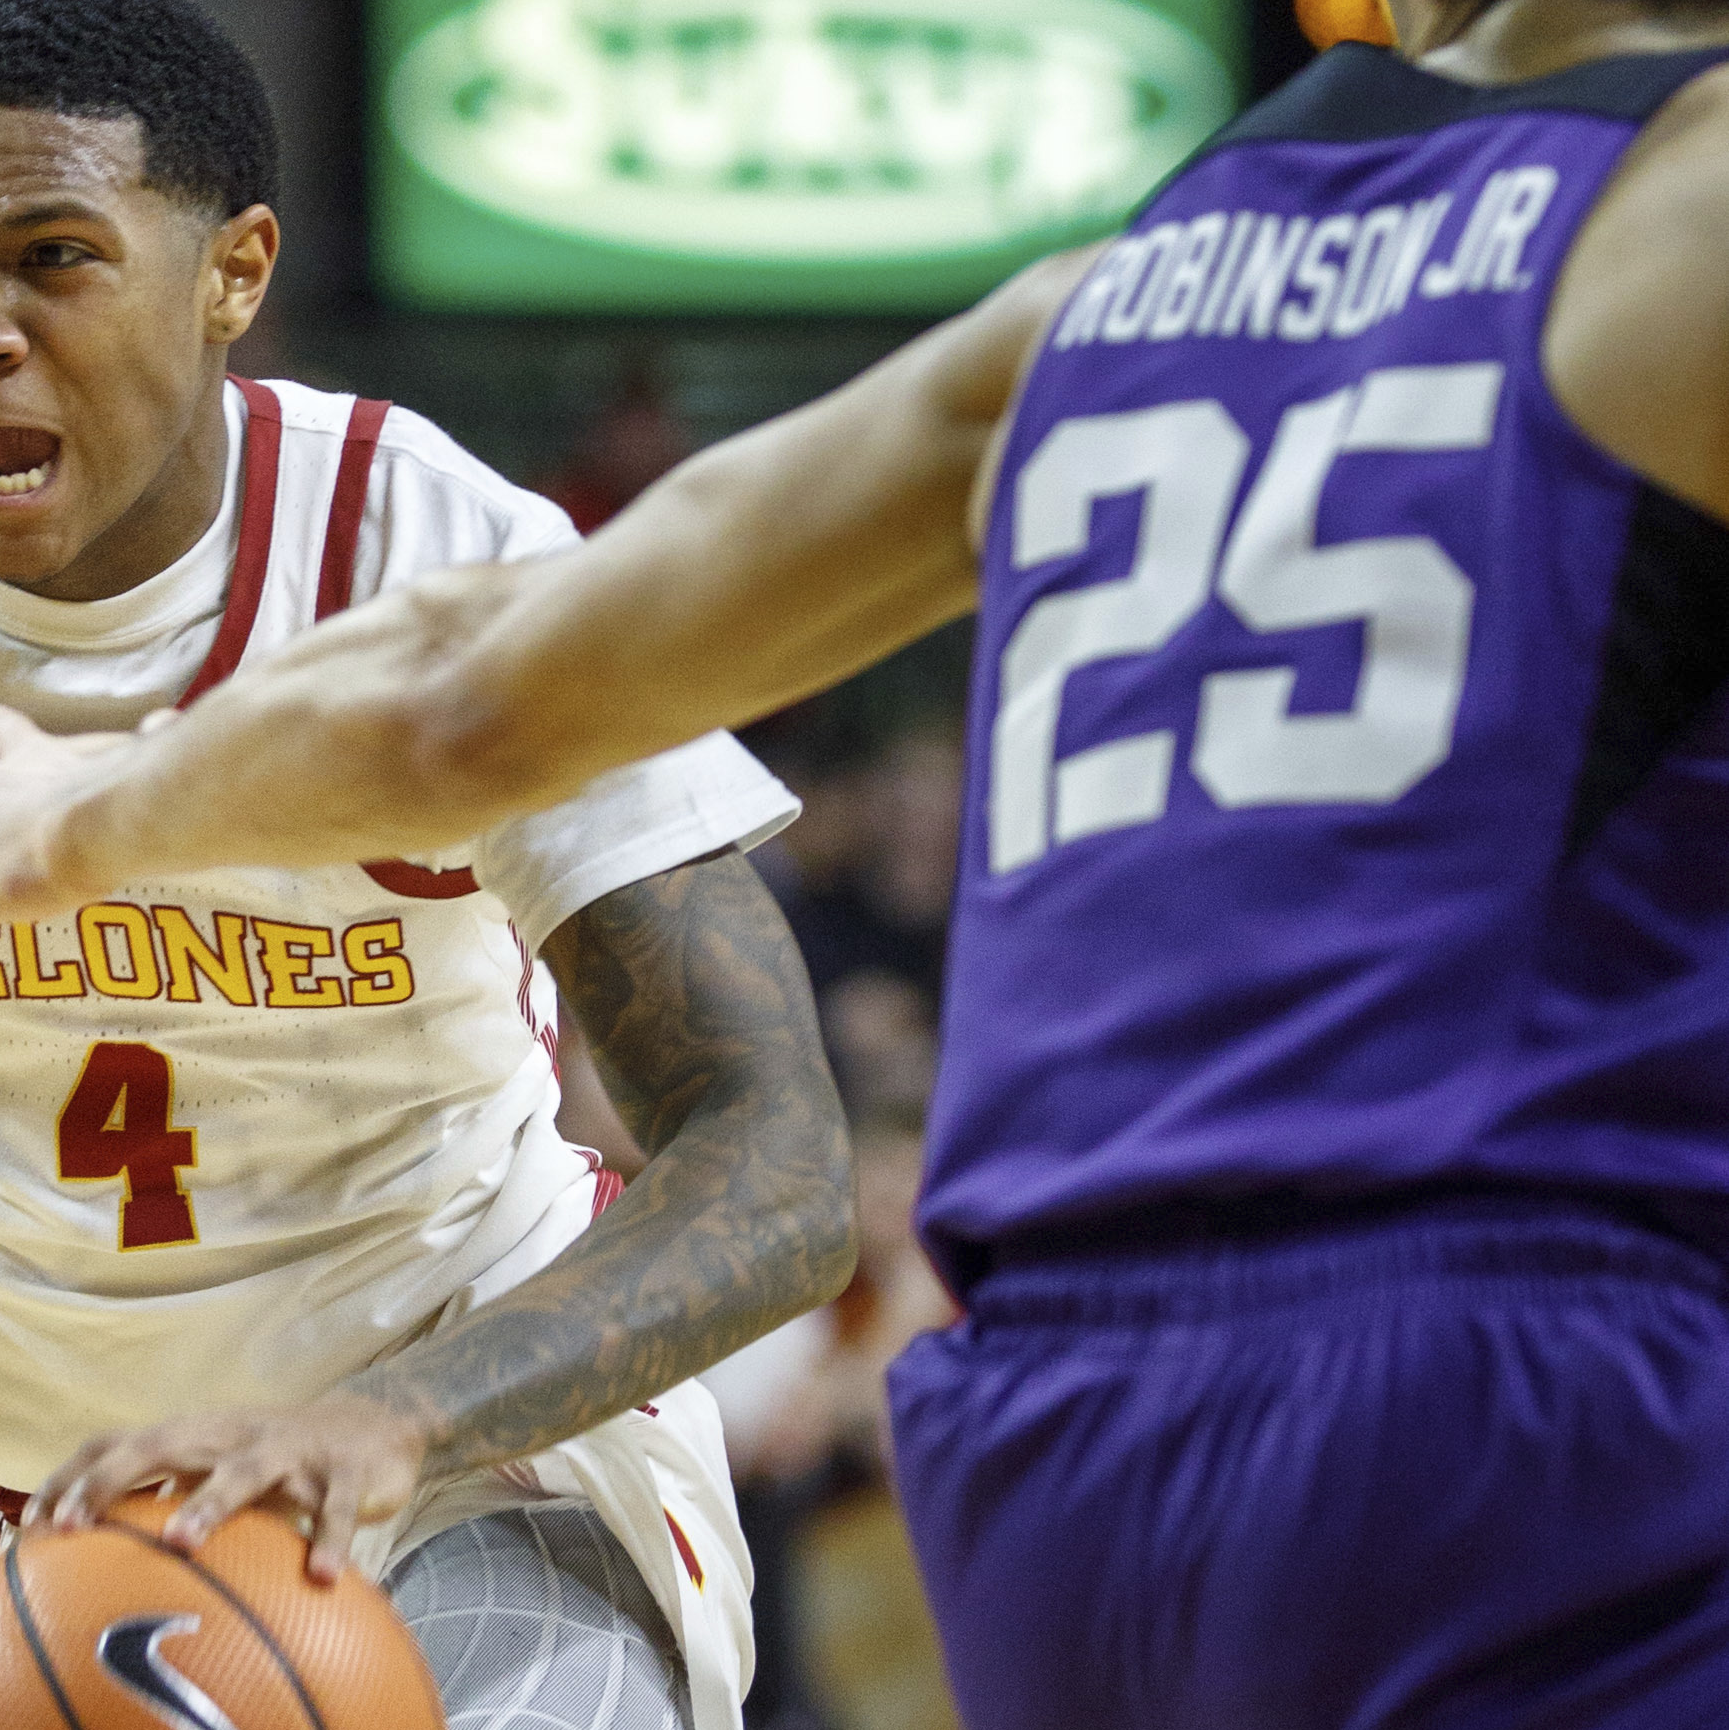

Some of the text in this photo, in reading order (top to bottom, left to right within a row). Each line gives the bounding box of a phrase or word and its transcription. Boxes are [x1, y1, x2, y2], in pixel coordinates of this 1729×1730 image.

[1053, 191, 1454, 352] ROBINSON
[988, 360, 1506, 877] 25
[54, 1039, 201, 1254] 4
